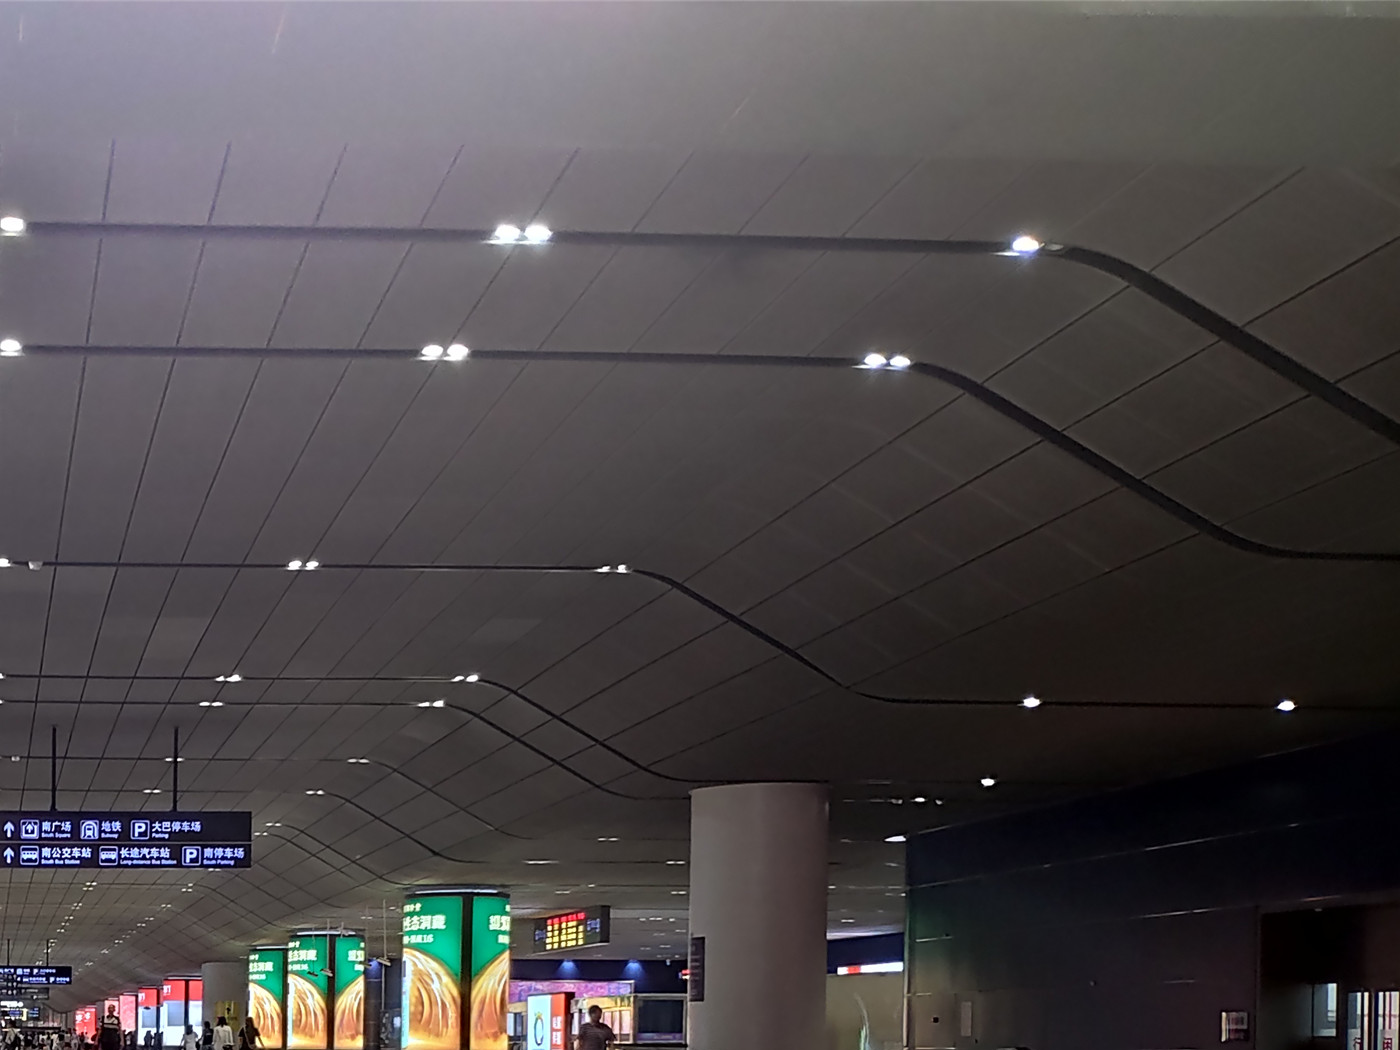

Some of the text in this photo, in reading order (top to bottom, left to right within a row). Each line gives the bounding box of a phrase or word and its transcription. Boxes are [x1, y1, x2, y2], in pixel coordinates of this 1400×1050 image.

[42, 821, 71, 832] 南广场
[101, 821, 122, 832] 地铁
[134, 823, 146, 837] P
[152, 821, 202, 833] 大巴停车场
[41, 847, 92, 858] 南公交车站
[120, 847, 170, 858] 长途汽车站
[185, 849, 197, 863] P
[203, 847, 245, 859] 南停车场
